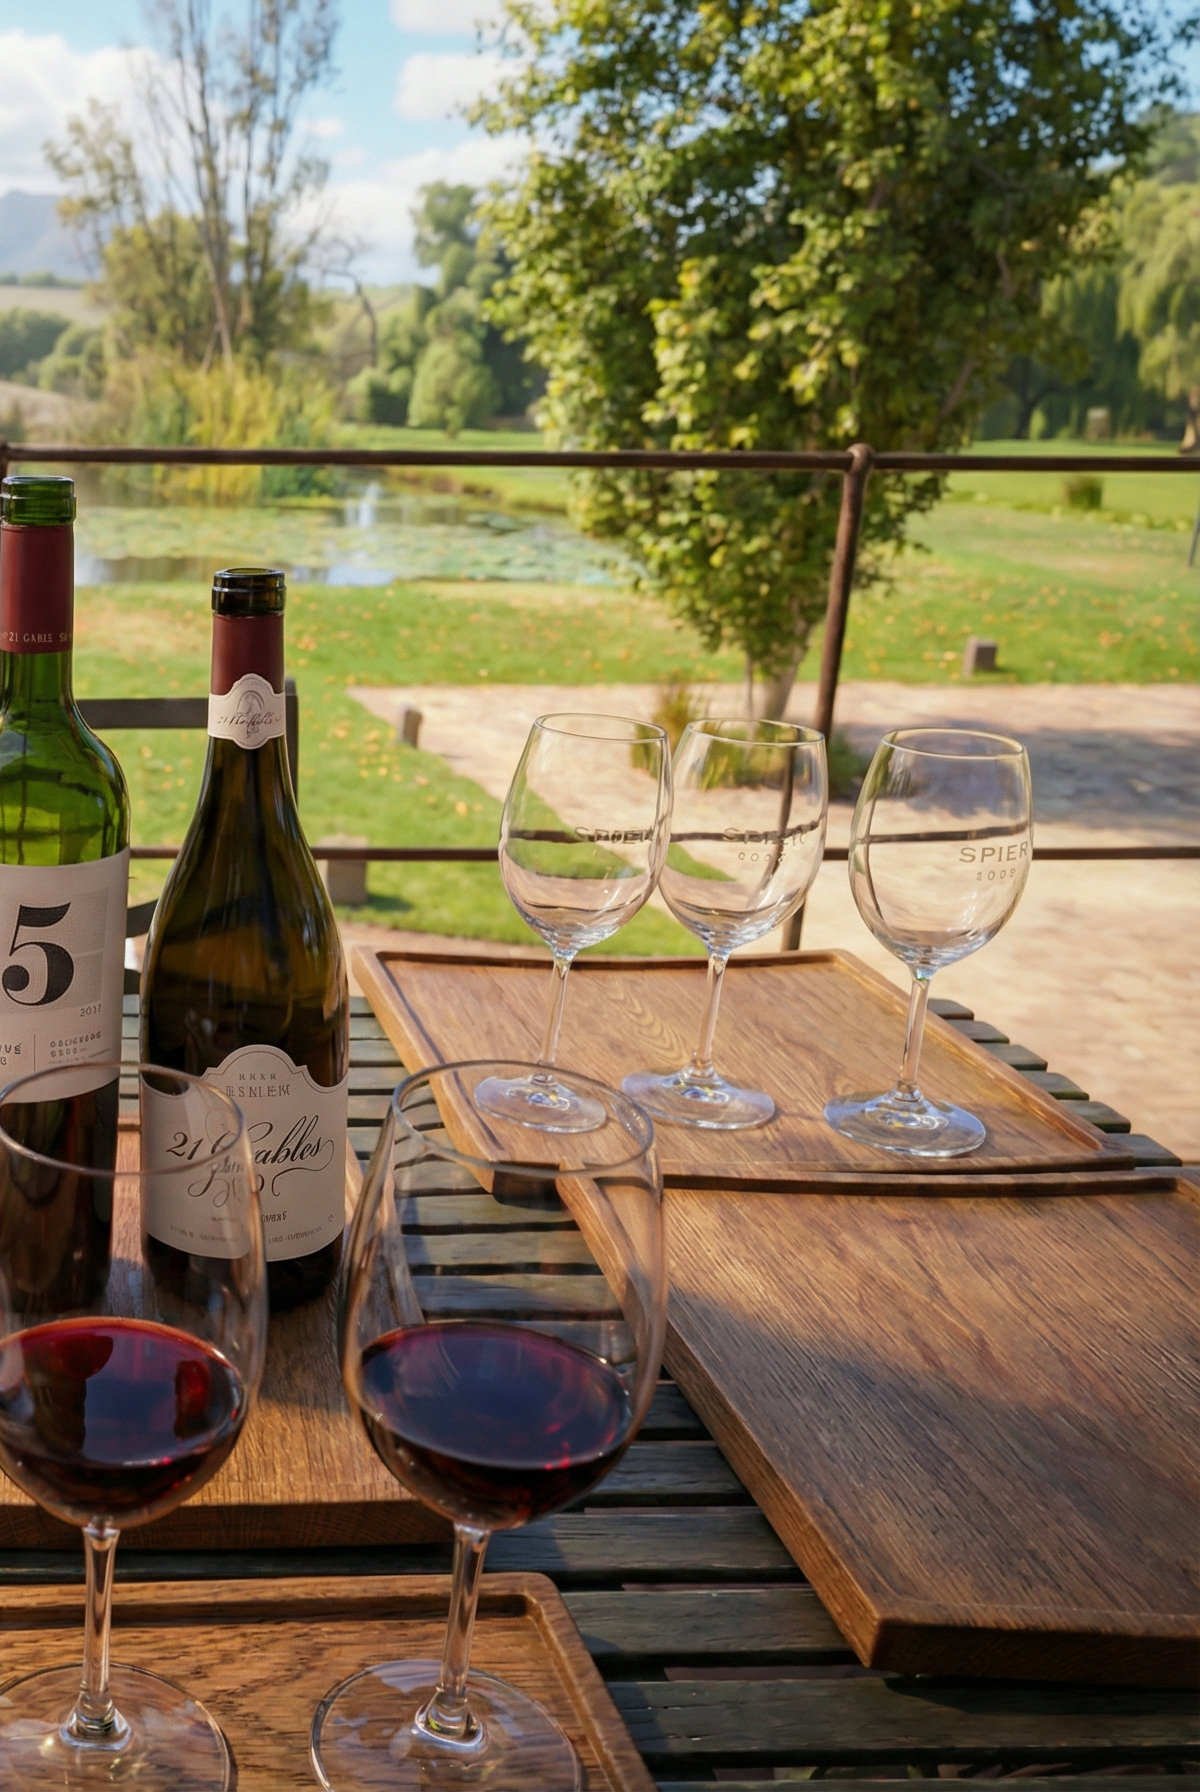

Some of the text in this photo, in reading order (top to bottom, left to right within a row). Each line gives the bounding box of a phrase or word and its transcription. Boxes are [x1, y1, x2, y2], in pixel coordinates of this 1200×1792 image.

[9, 632, 18, 642] 21
[959, 841, 1029, 863] SPIER
[2, 901, 75, 1007] 5
[165, 1131, 204, 1161] 21
